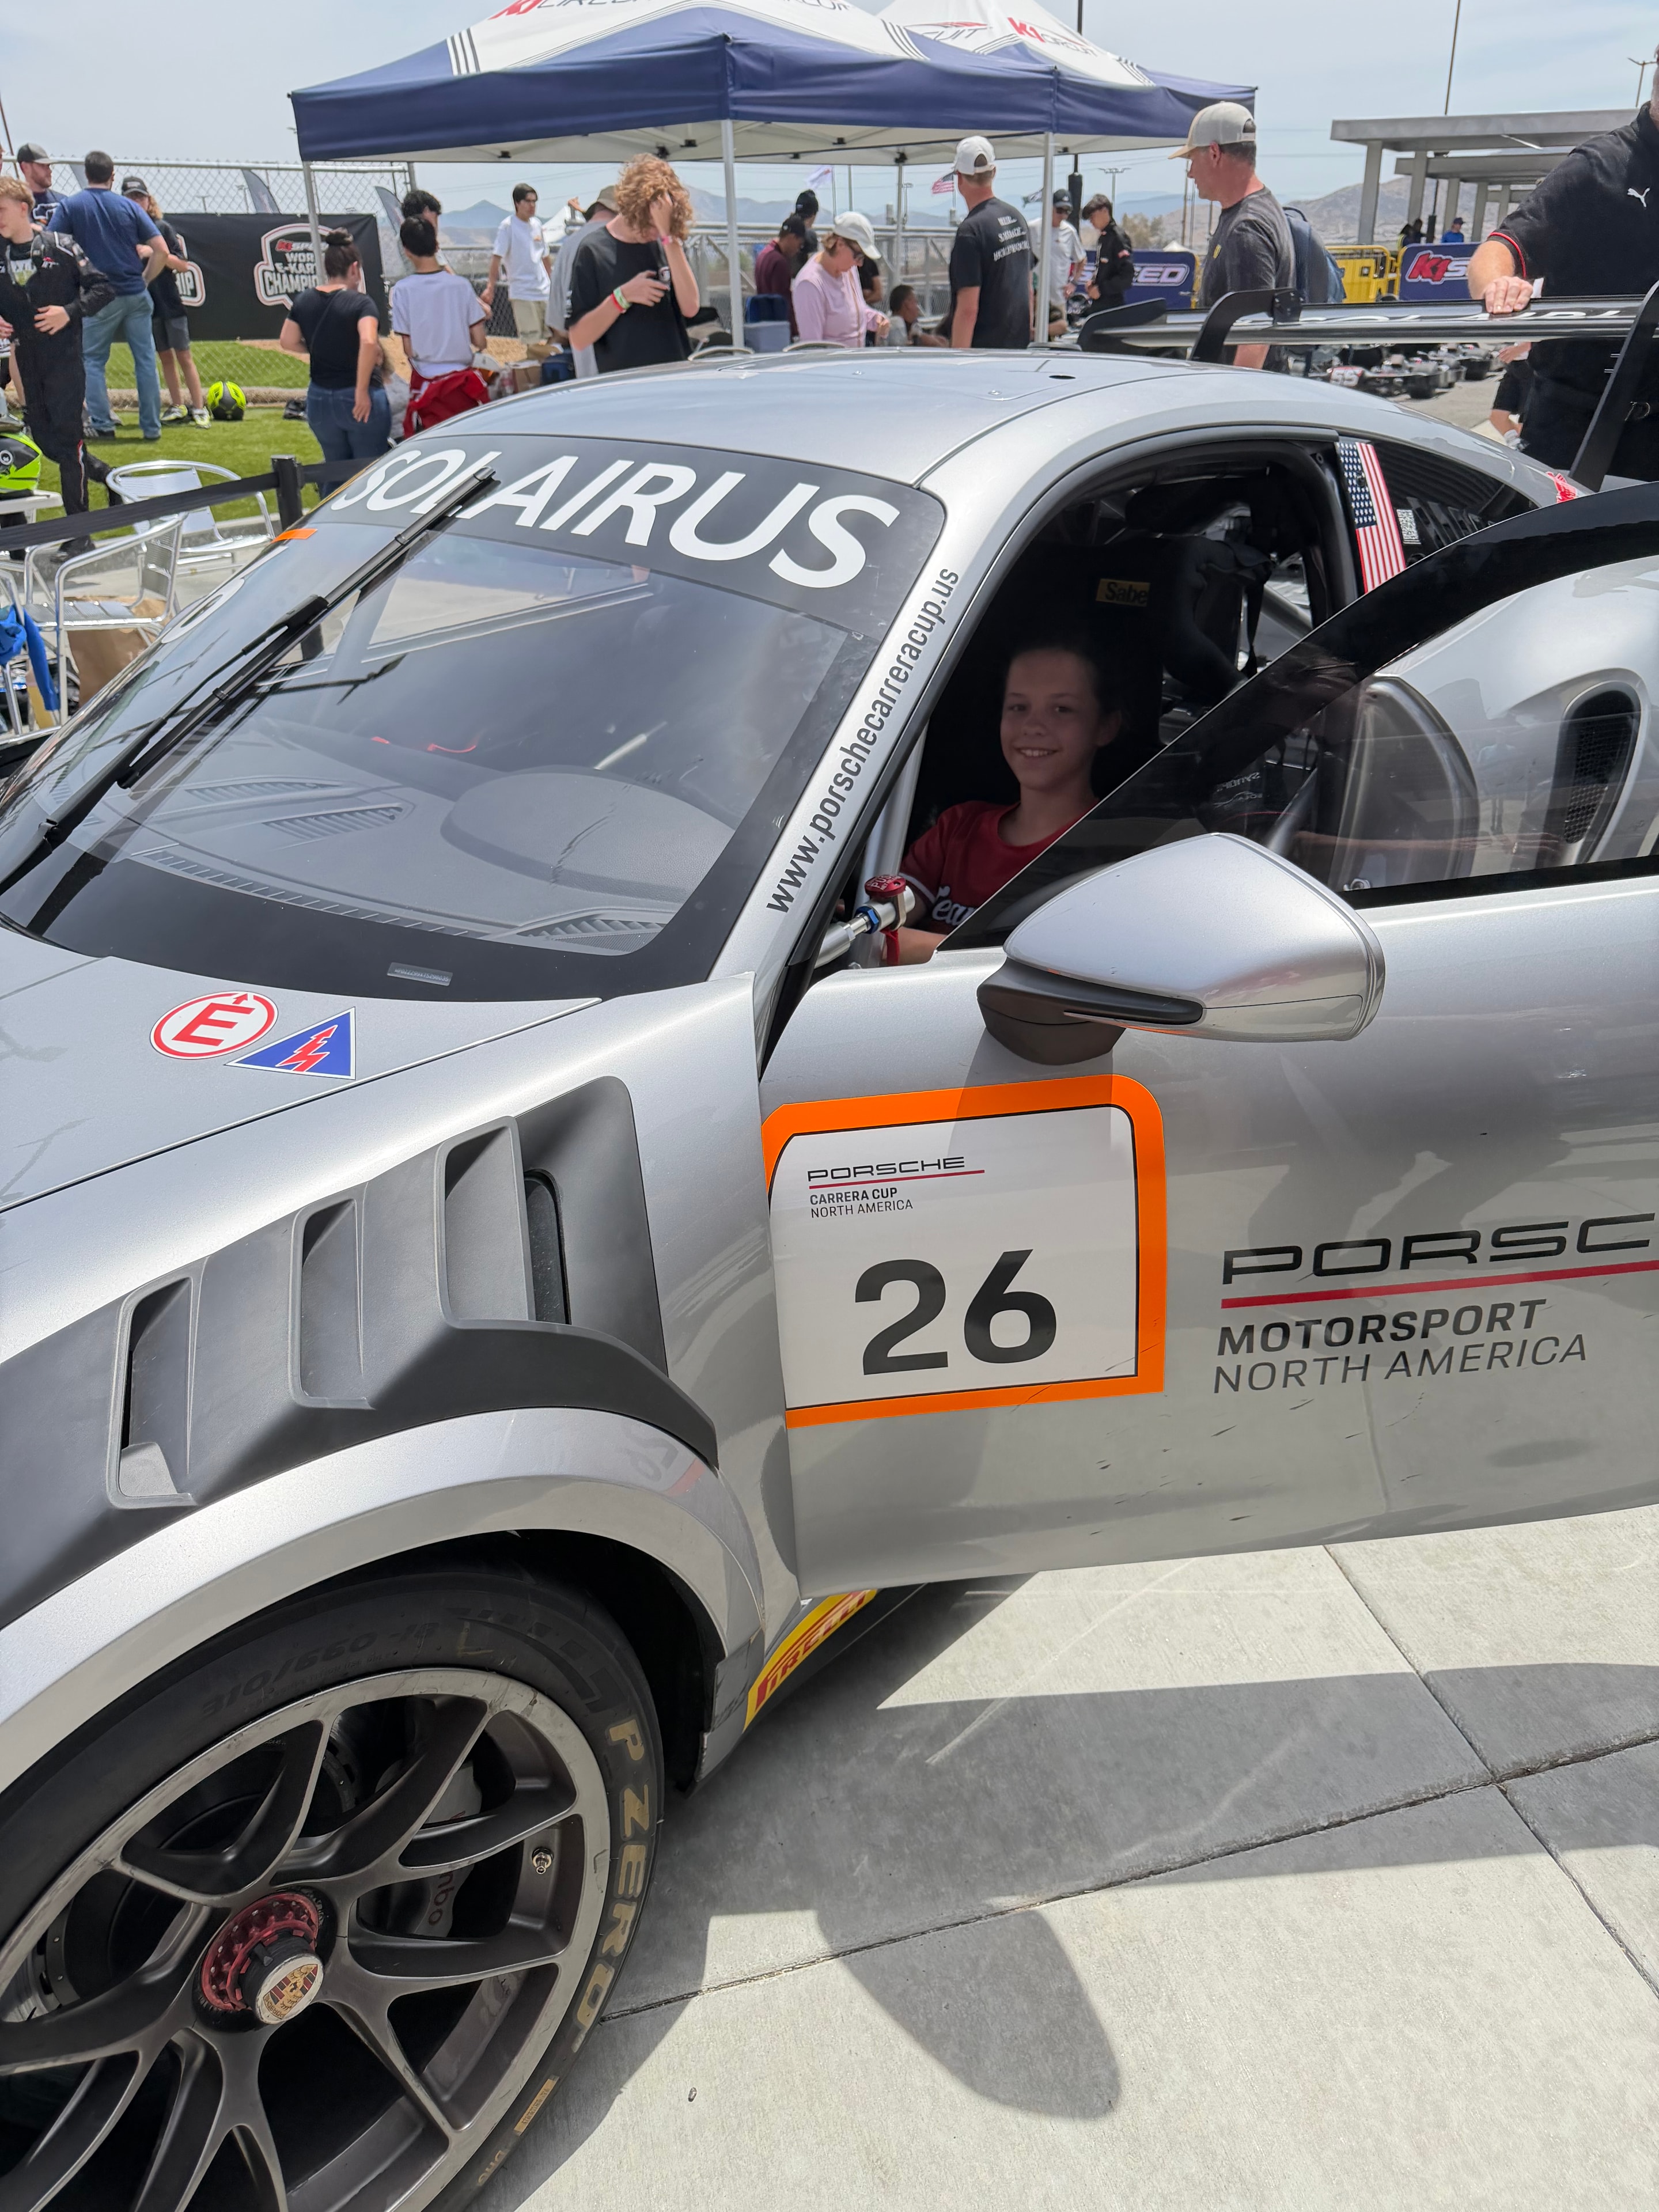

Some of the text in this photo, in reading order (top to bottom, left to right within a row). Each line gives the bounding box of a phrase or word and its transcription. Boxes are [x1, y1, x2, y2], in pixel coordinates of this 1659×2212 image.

[285, 252, 315, 263] WOR
[331, 449, 900, 588] SOLAIRUS
[1105, 581, 1149, 605] Sabe
[766, 568, 959, 914] www.porschecarreracup.us
[808, 1157, 965, 1181] PORSCHE
[809, 1187, 898, 1205] CARRERA CUP
[811, 1199, 914, 1218] NORTH AMERICA
[1222, 1213, 1656, 1285] PORSC
[855, 1249, 1056, 1376] 26
[1217, 1298, 1547, 1356] MOTORSPORT
[1213, 1334, 1588, 1394] NORTH AMERICA
[575, 1783, 650, 2030] ZERO
